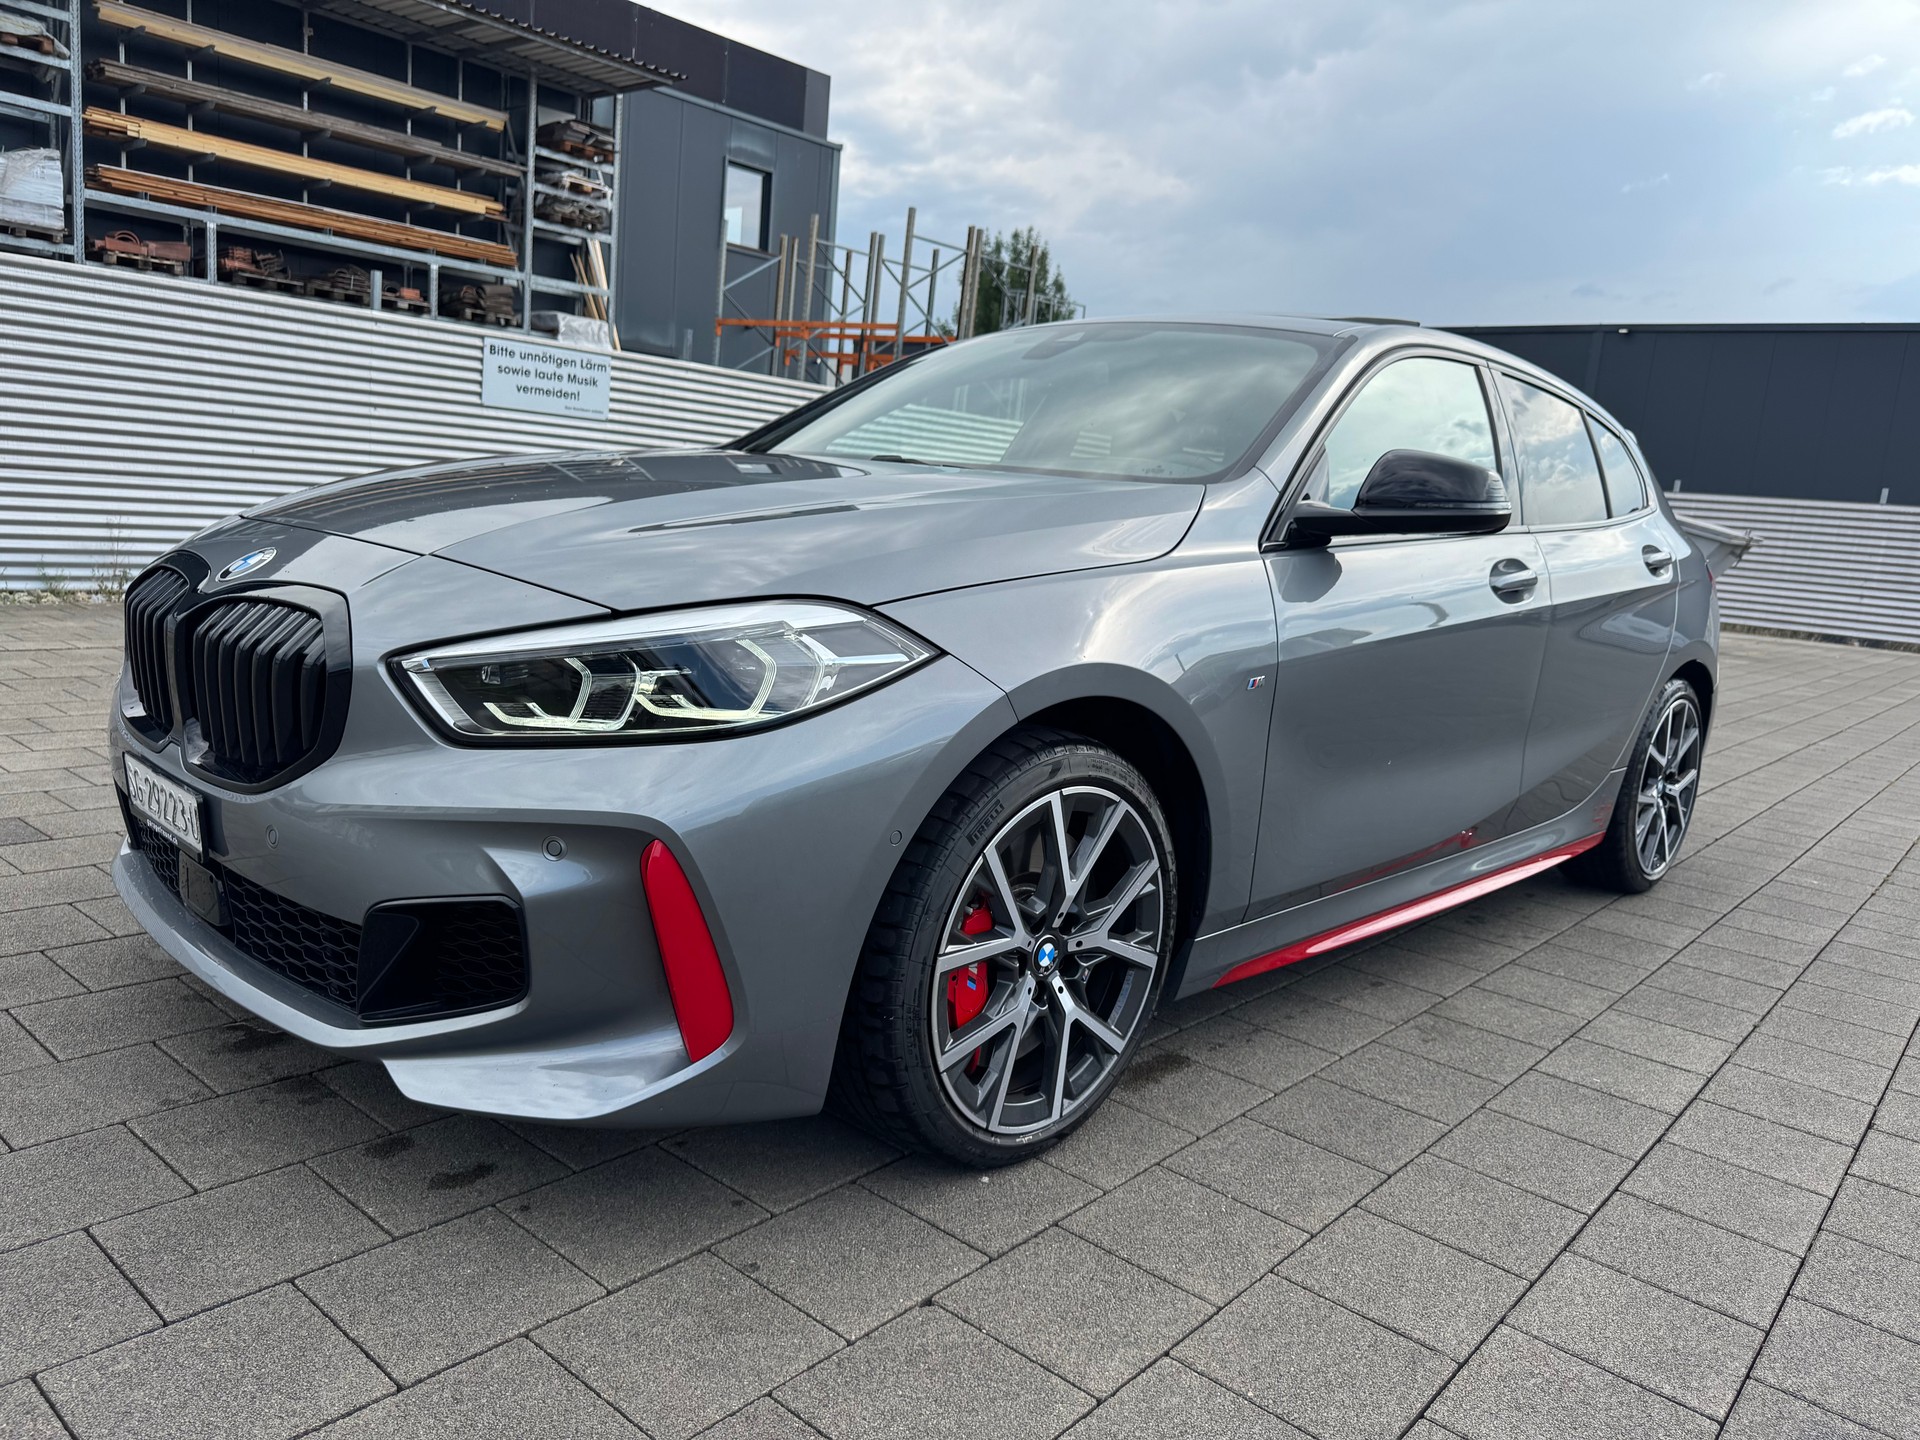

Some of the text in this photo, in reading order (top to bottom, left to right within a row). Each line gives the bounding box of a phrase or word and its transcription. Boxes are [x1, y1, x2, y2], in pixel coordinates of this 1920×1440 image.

[489, 344, 607, 373] Bitte unnötigen Lärm
[497, 365, 598, 388] sowie laute Musik
[516, 384, 580, 401] vermeiden!
[965, 799, 1005, 847] PIRELLI
